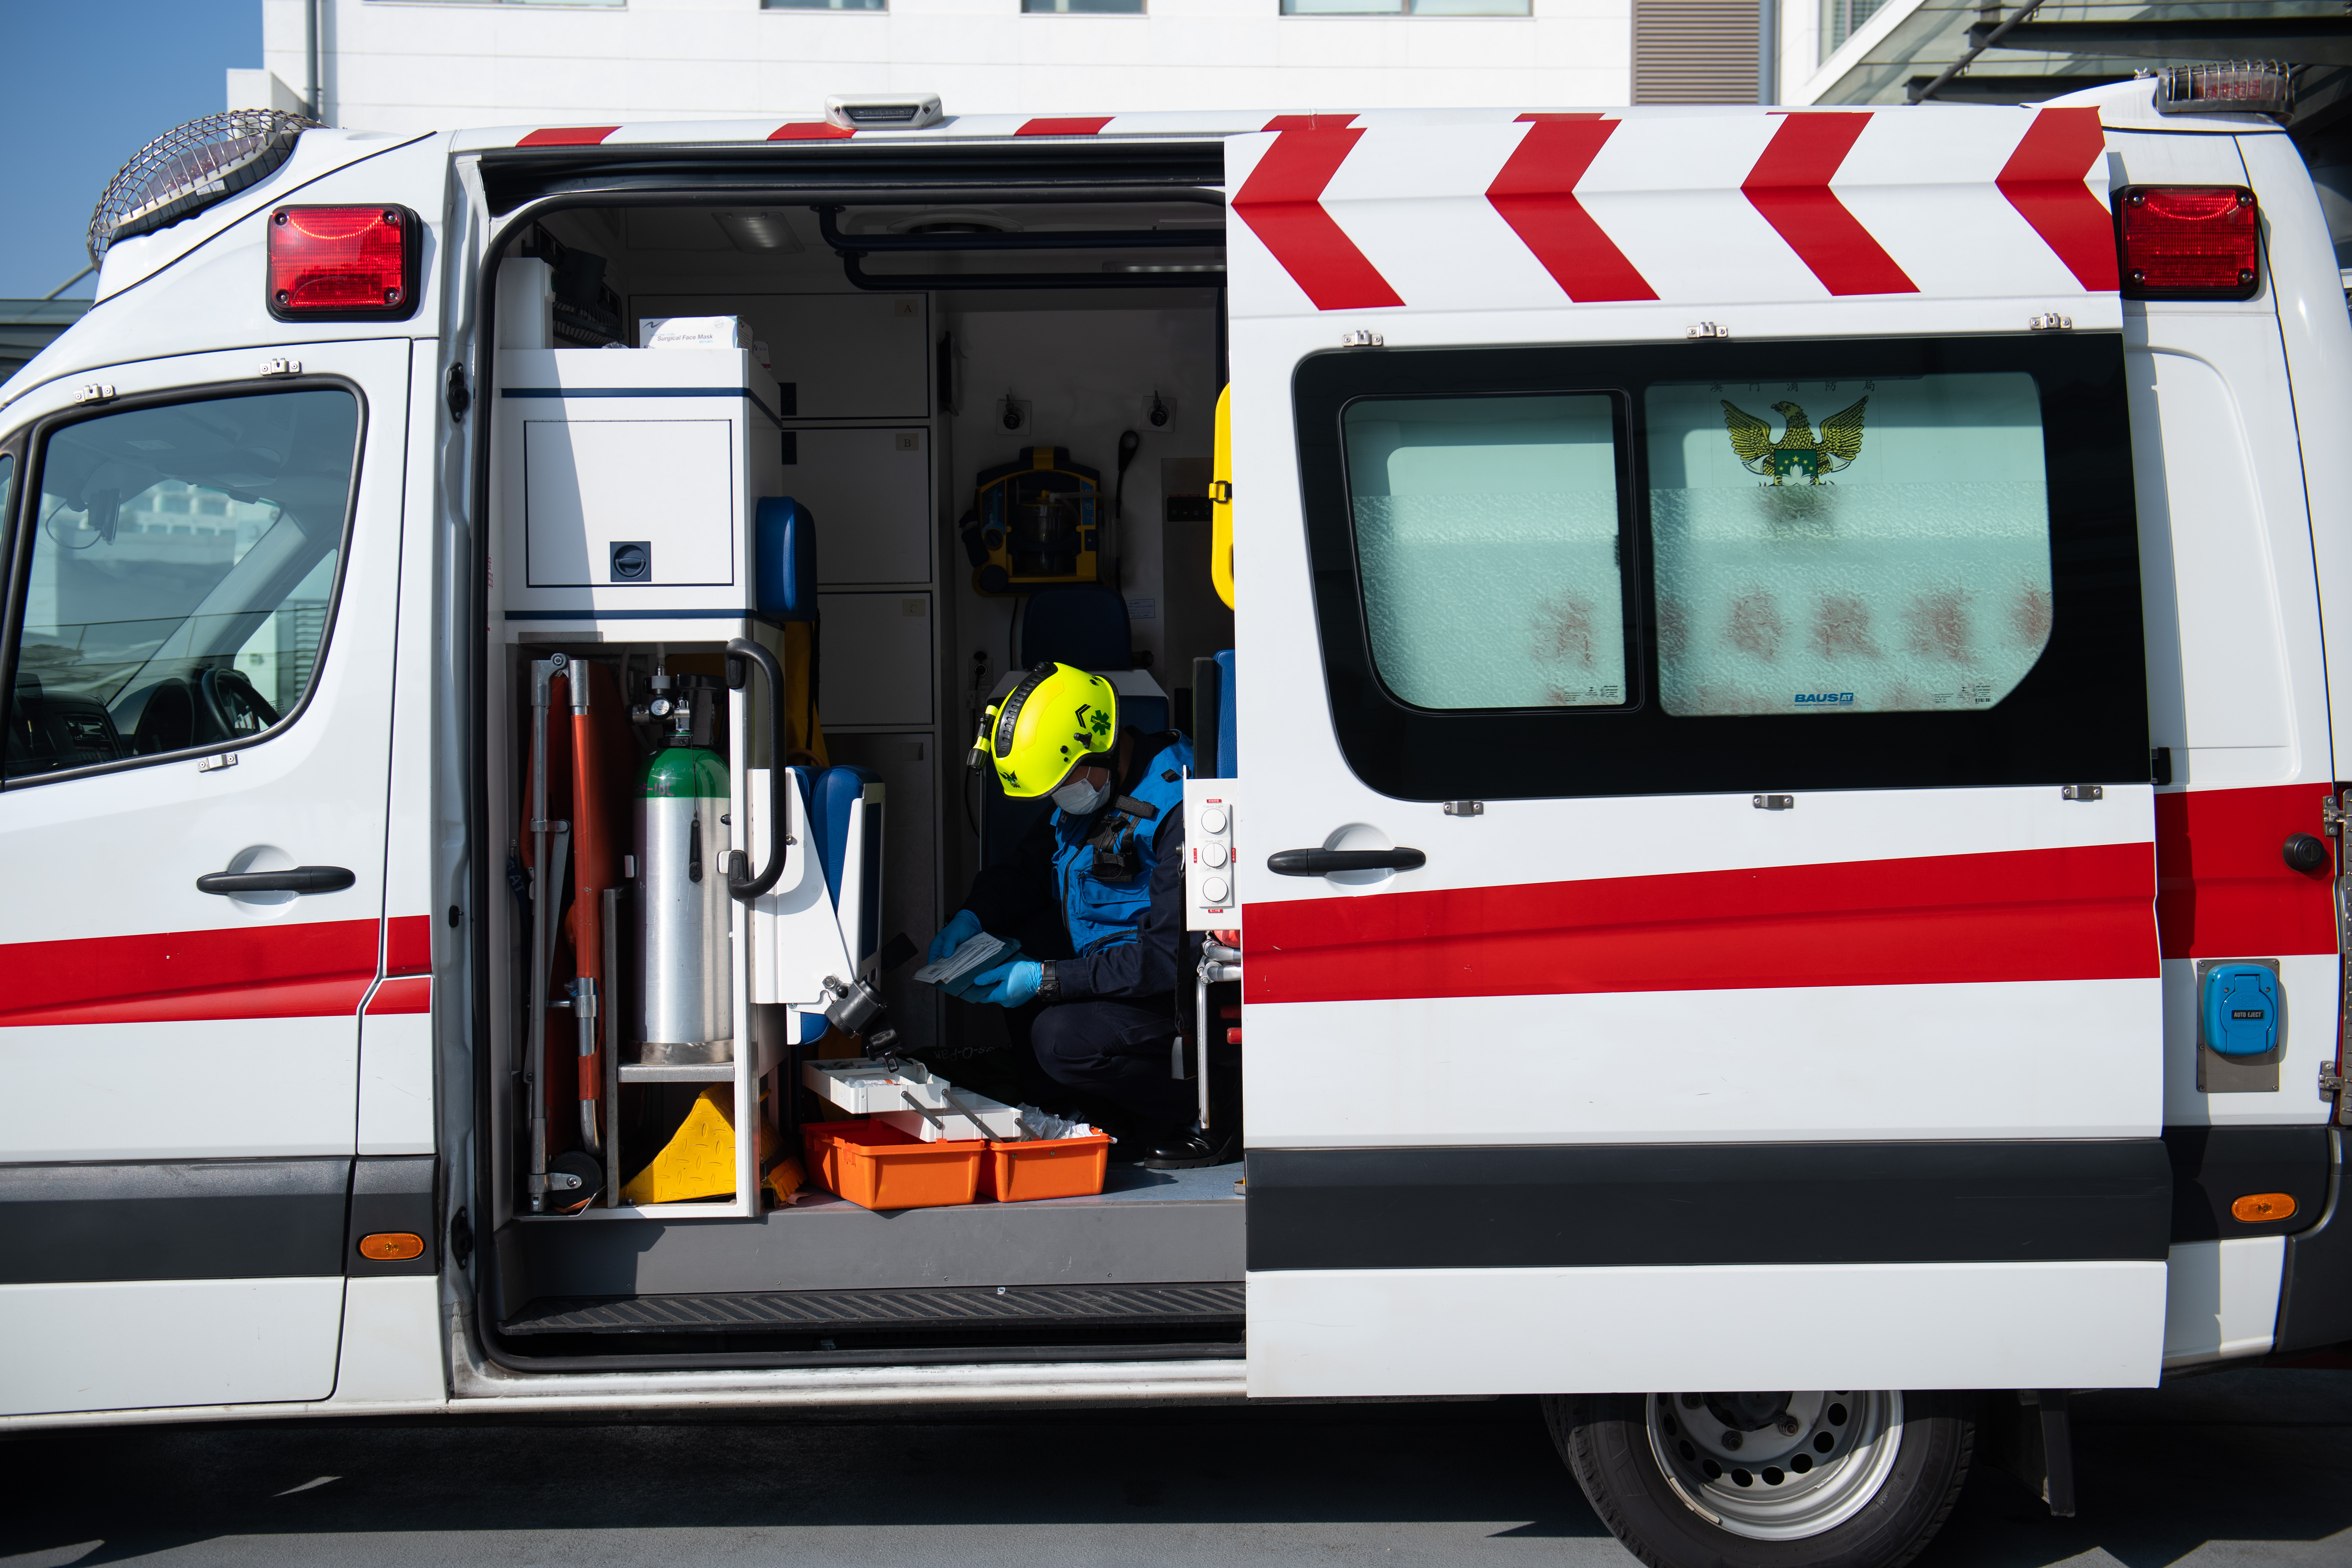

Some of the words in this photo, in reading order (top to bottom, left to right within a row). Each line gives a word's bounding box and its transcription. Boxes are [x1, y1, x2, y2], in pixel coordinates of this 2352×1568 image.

[904, 305, 912, 313] A
[903, 439, 912, 447] B
[1794, 693, 1839, 702] BAUS
